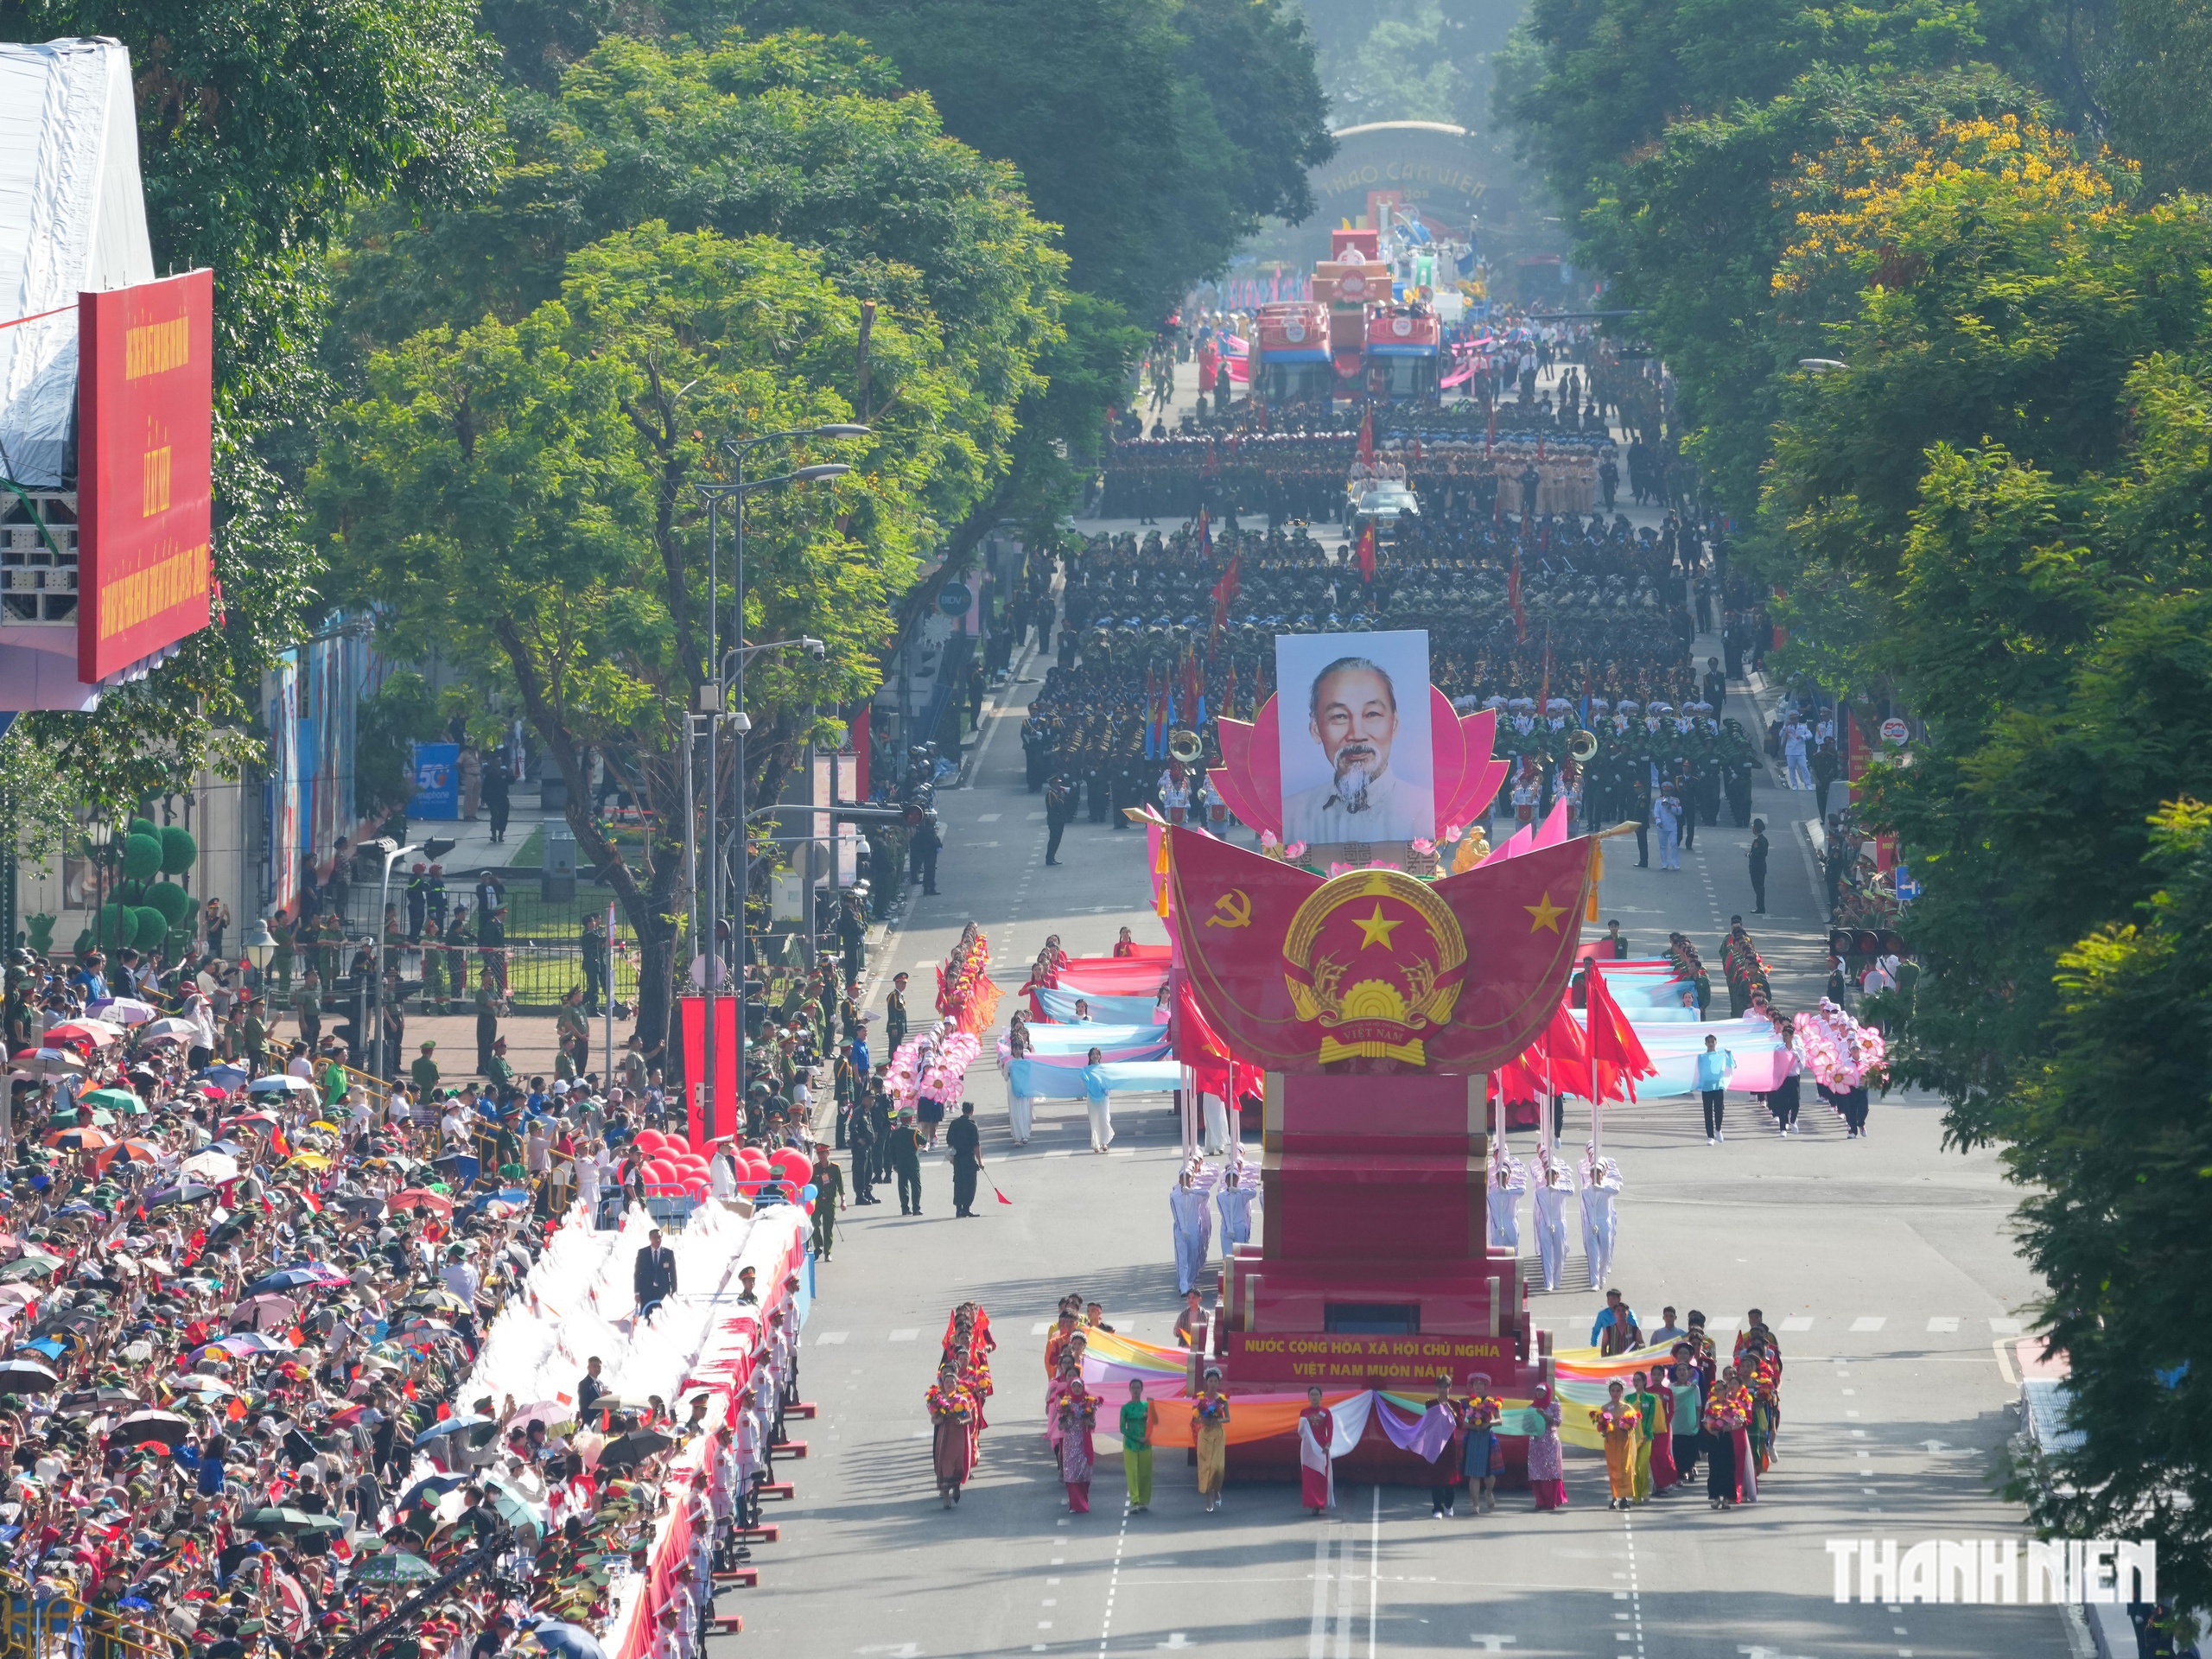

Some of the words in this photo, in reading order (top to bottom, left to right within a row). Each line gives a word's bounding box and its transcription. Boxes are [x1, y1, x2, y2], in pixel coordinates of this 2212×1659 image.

[1343, 1027, 1373, 1040] VIỆT
[1376, 1028, 1404, 1043] NAM
[1245, 1337, 1285, 1353] NƯỚC
[1288, 1338, 1328, 1355] CỘNG
[1331, 1340, 1363, 1355] HÒA
[1368, 1341, 1389, 1355] XÃ
[1393, 1341, 1420, 1357] HỘI
[1422, 1340, 1451, 1356] CHỦ
[1454, 1343, 1501, 1357] NGHĨA
[1293, 1361, 1326, 1378] VIỆT
[1330, 1363, 1363, 1376] NAM
[1367, 1363, 1410, 1377] MUÔN
